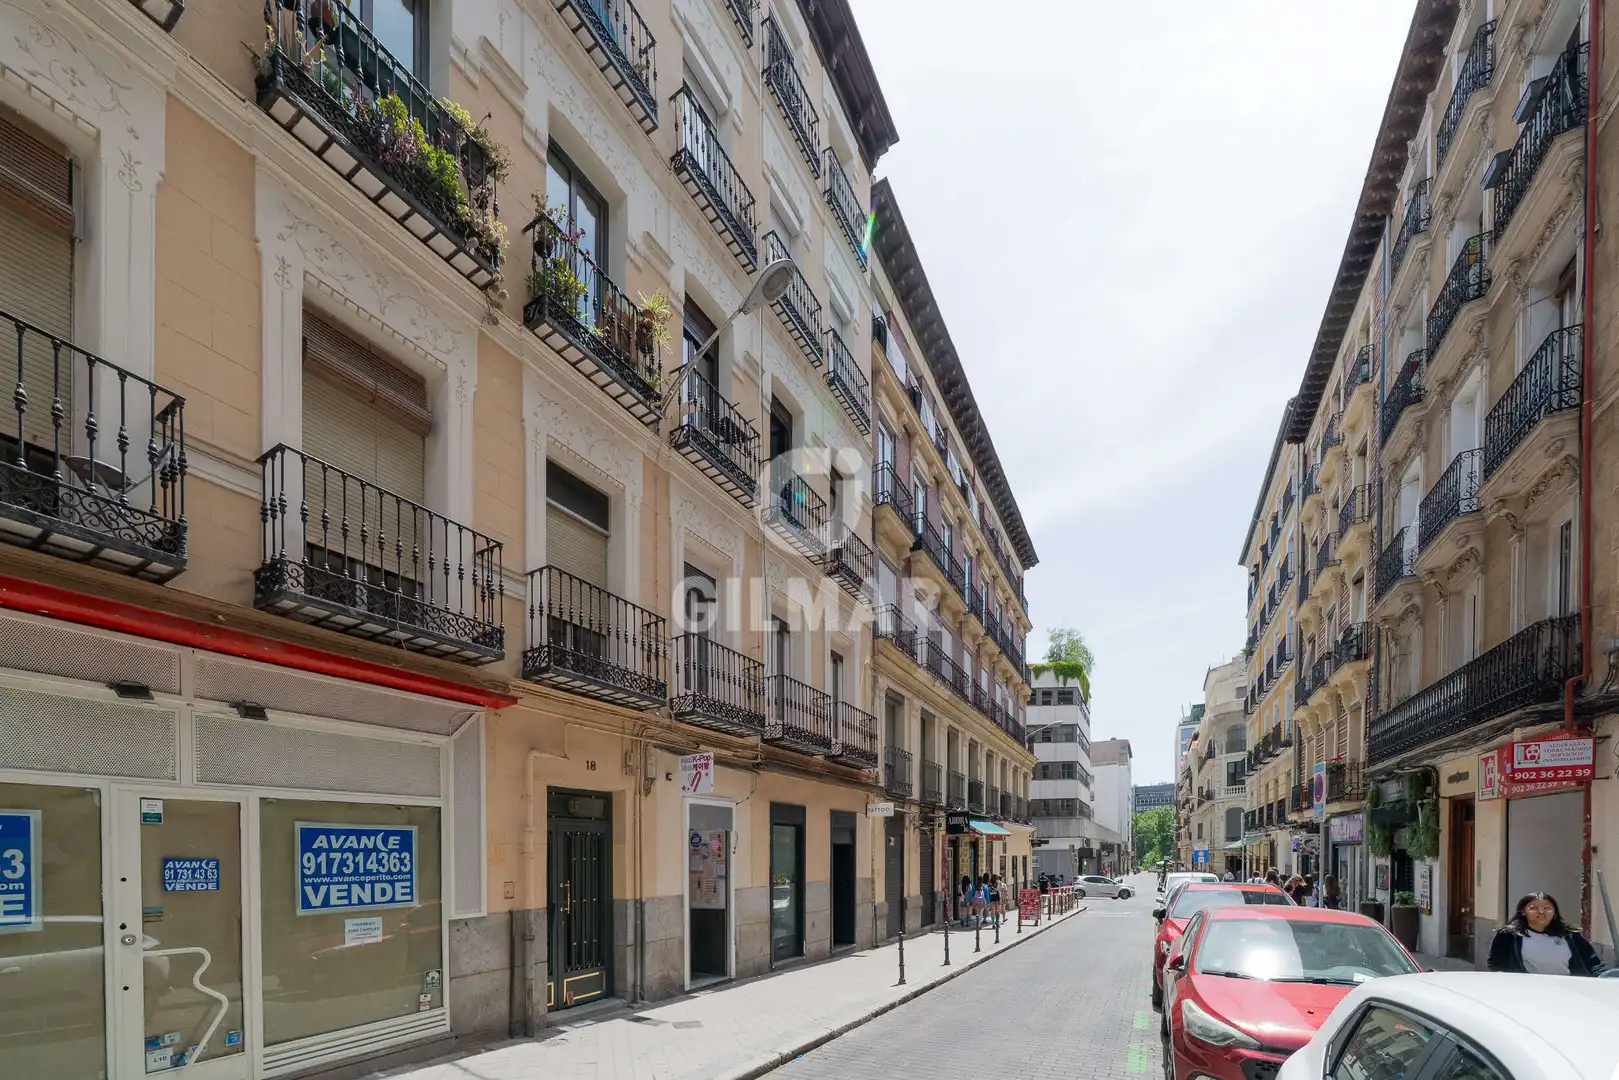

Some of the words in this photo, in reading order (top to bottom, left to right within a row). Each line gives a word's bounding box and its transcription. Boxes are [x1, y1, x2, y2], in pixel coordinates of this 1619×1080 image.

[585, 760, 597, 771] 18
[1515, 772, 1536, 780] 902
[1540, 770, 1554, 779] 36
[1557, 769, 1572, 778] 22
[1576, 768, 1591, 777] 39
[1512, 785, 1525, 793] 902
[312, 832, 401, 851] AVANCE
[165, 860, 217, 869] AVANCE
[303, 852, 411, 875] 917314363
[165, 869, 174, 879] 91
[177, 869, 192, 879] 731
[195, 869, 204, 879] 43
[207, 869, 218, 879] 63
[304, 882, 412, 907] VENDE
